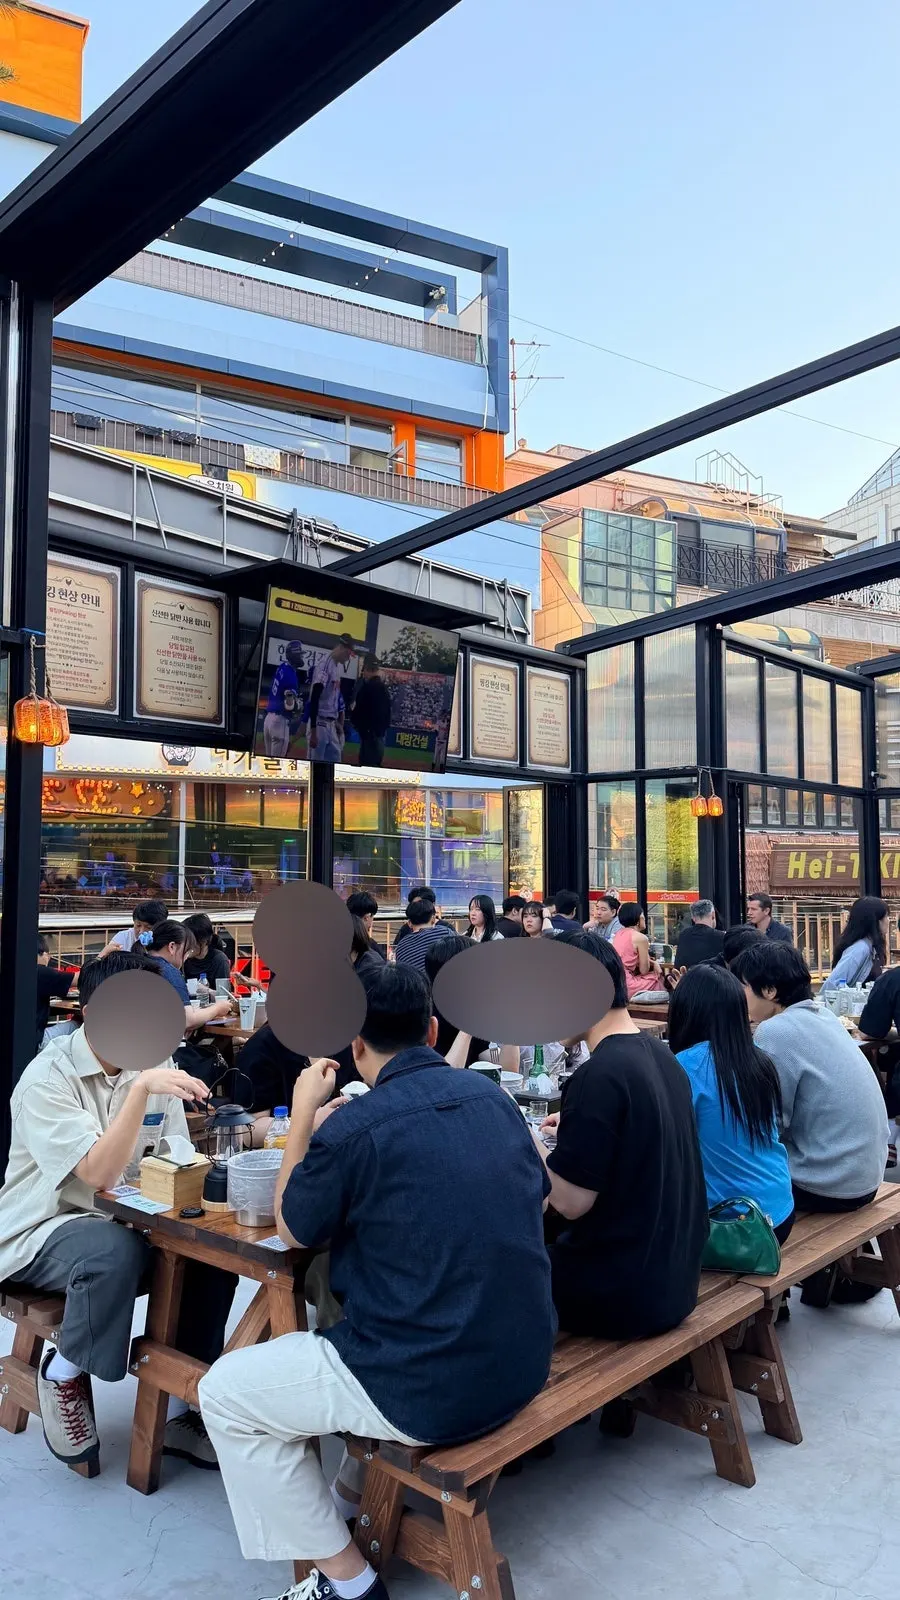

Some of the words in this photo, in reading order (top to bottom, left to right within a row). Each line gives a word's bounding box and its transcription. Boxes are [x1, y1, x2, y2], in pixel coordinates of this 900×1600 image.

[58, 588, 78, 602] 현상
[81, 593, 100, 607] 안내
[152, 609, 169, 619] 신선한
[182, 616, 193, 625] 사용
[195, 618, 211, 629] 합니다
[396, 732, 429, 749] 대방건설
